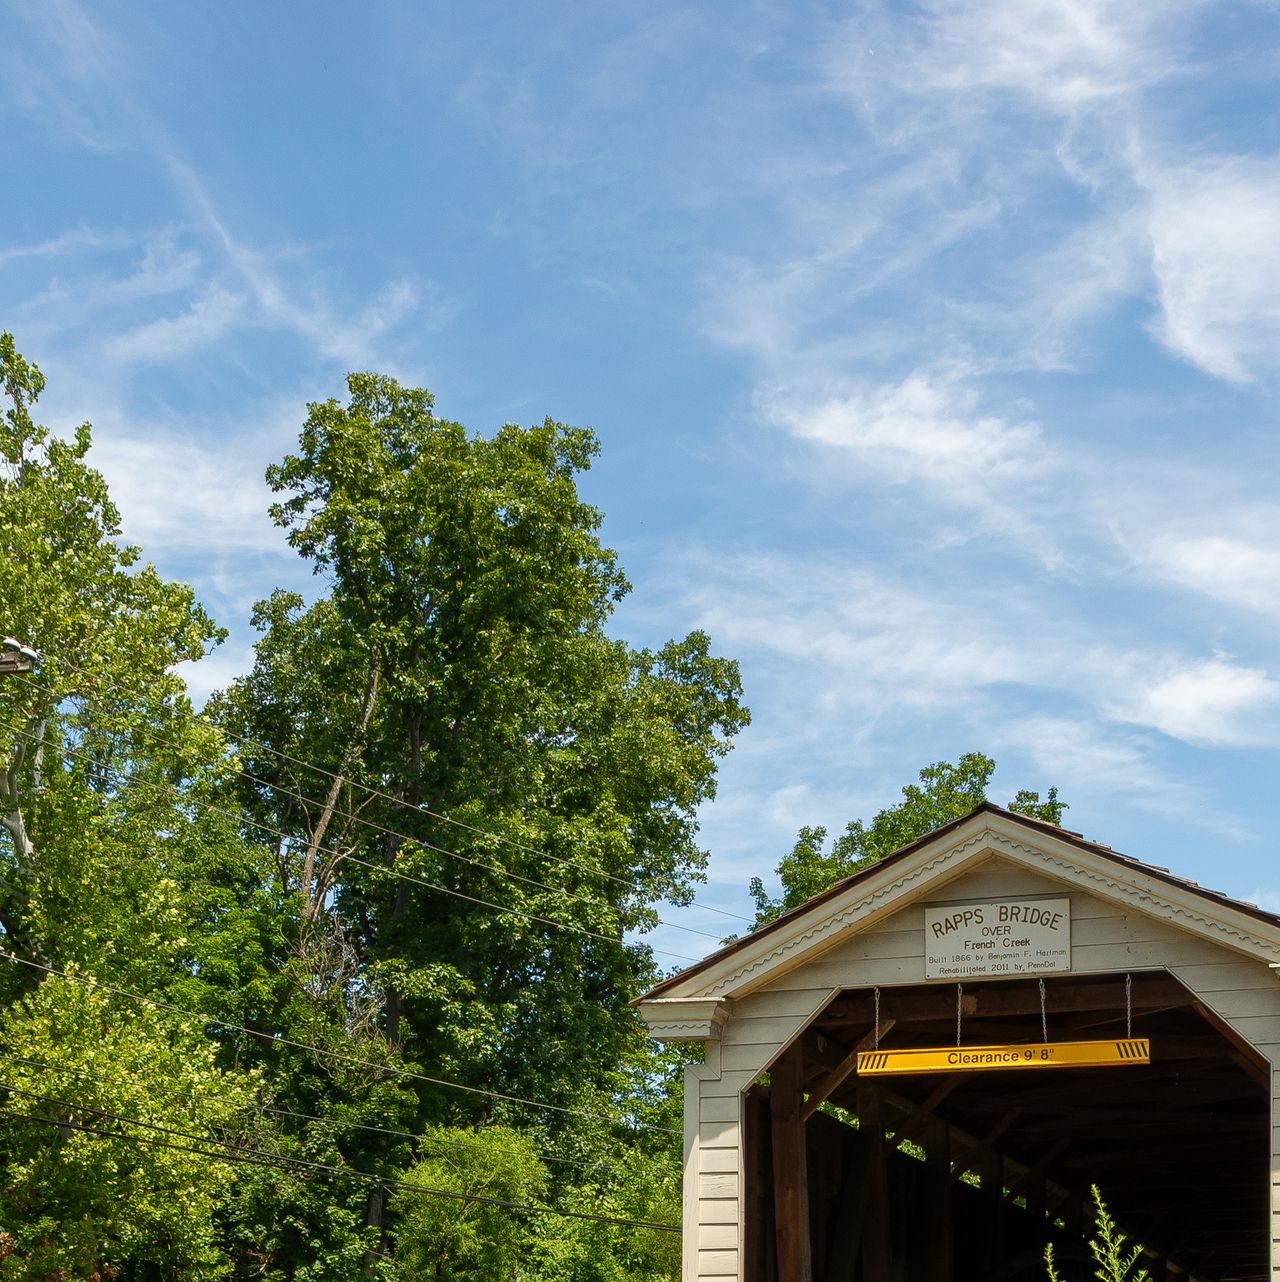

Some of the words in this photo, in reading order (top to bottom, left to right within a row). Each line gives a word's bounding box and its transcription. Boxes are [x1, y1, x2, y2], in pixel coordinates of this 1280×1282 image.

[932, 909, 984, 938] RAPPS
[999, 906, 1063, 930] BRIDGE
[982, 926, 1011, 936] OVER
[965, 940, 995, 950] French
[1003, 938, 1030, 947] Creek
[988, 952, 1019, 960] Benjamin
[940, 966, 986, 975] Rehabilitated
[948, 1051, 1018, 1064] Clearance
[1024, 1050, 1036, 1061] 9'
[1041, 1049, 1054, 1060] 8"
